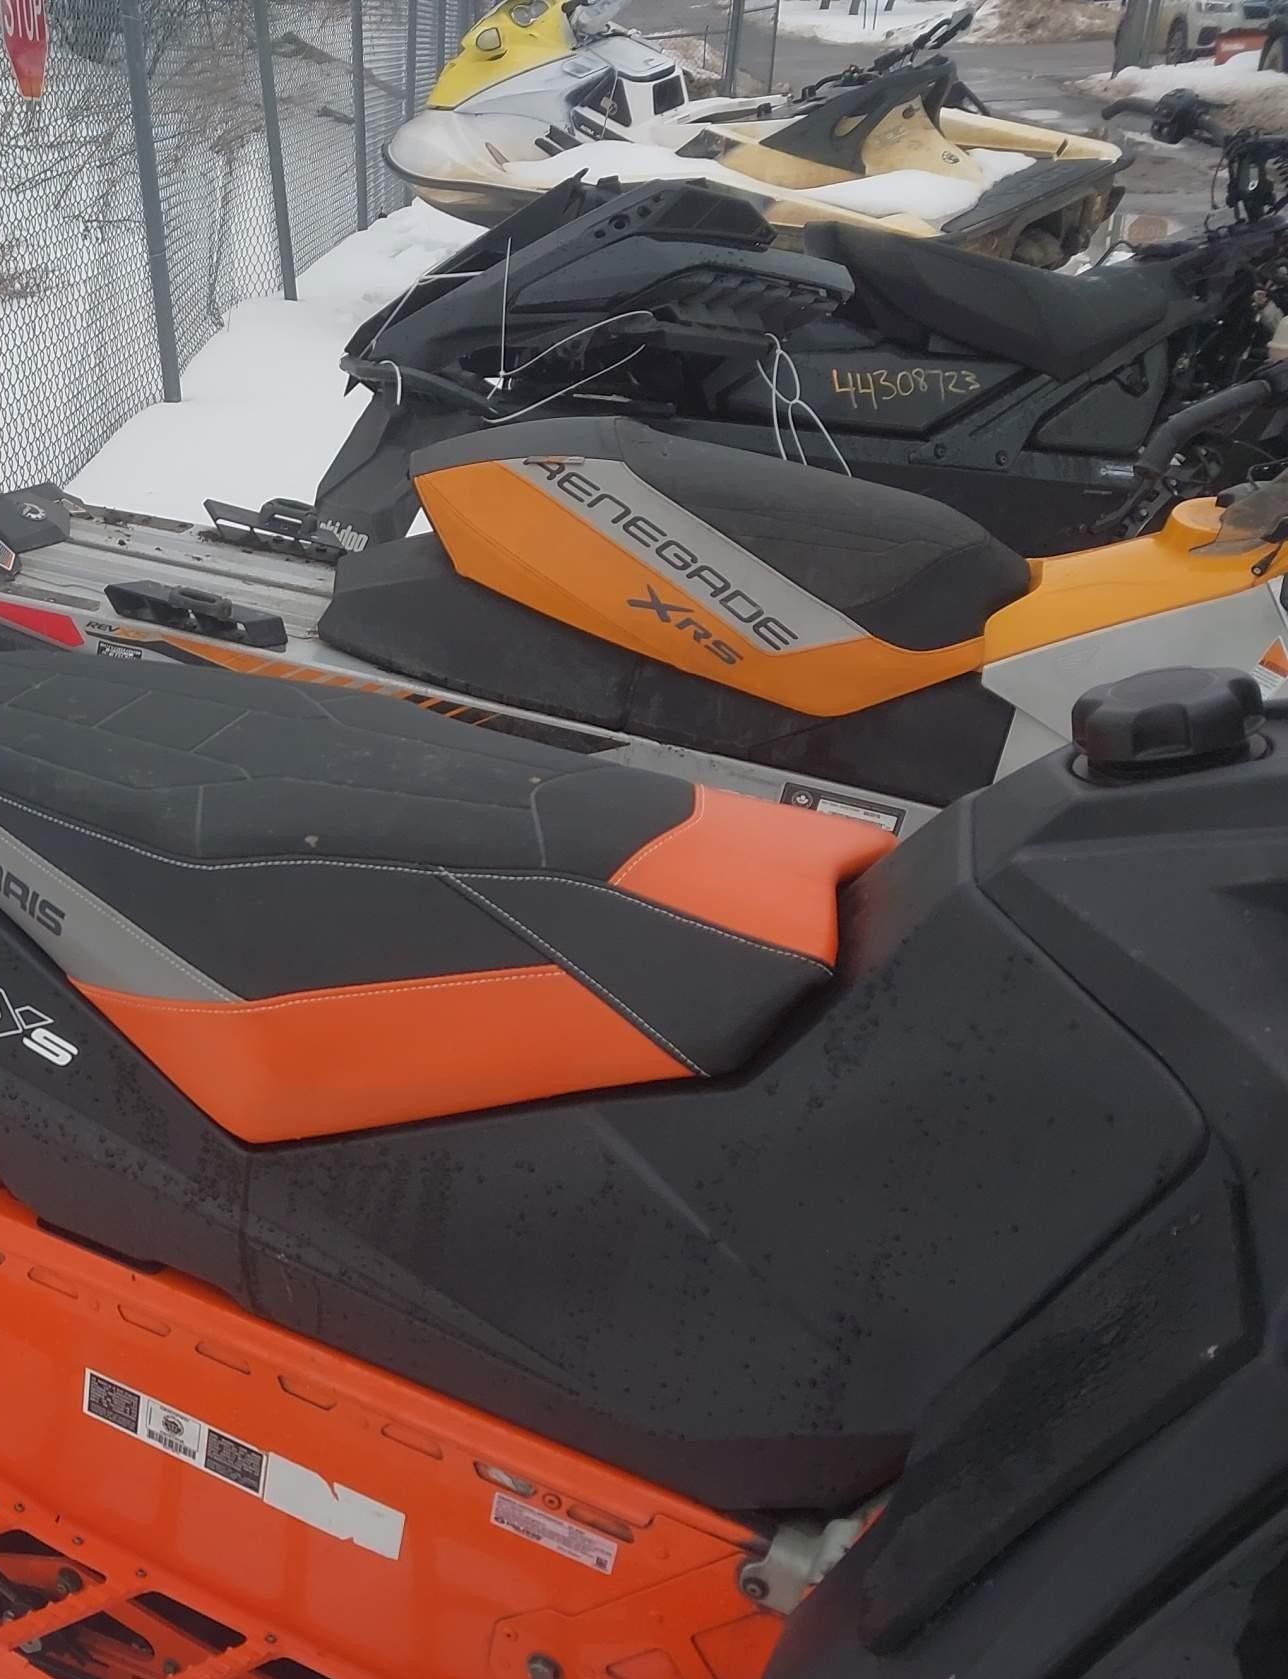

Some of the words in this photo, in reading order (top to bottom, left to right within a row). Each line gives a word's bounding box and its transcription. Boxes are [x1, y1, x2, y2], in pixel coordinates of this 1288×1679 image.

[832, 368, 981, 410] 44308723
[523, 459, 799, 651] RENEGADE
[86, 621, 120, 632] REV
